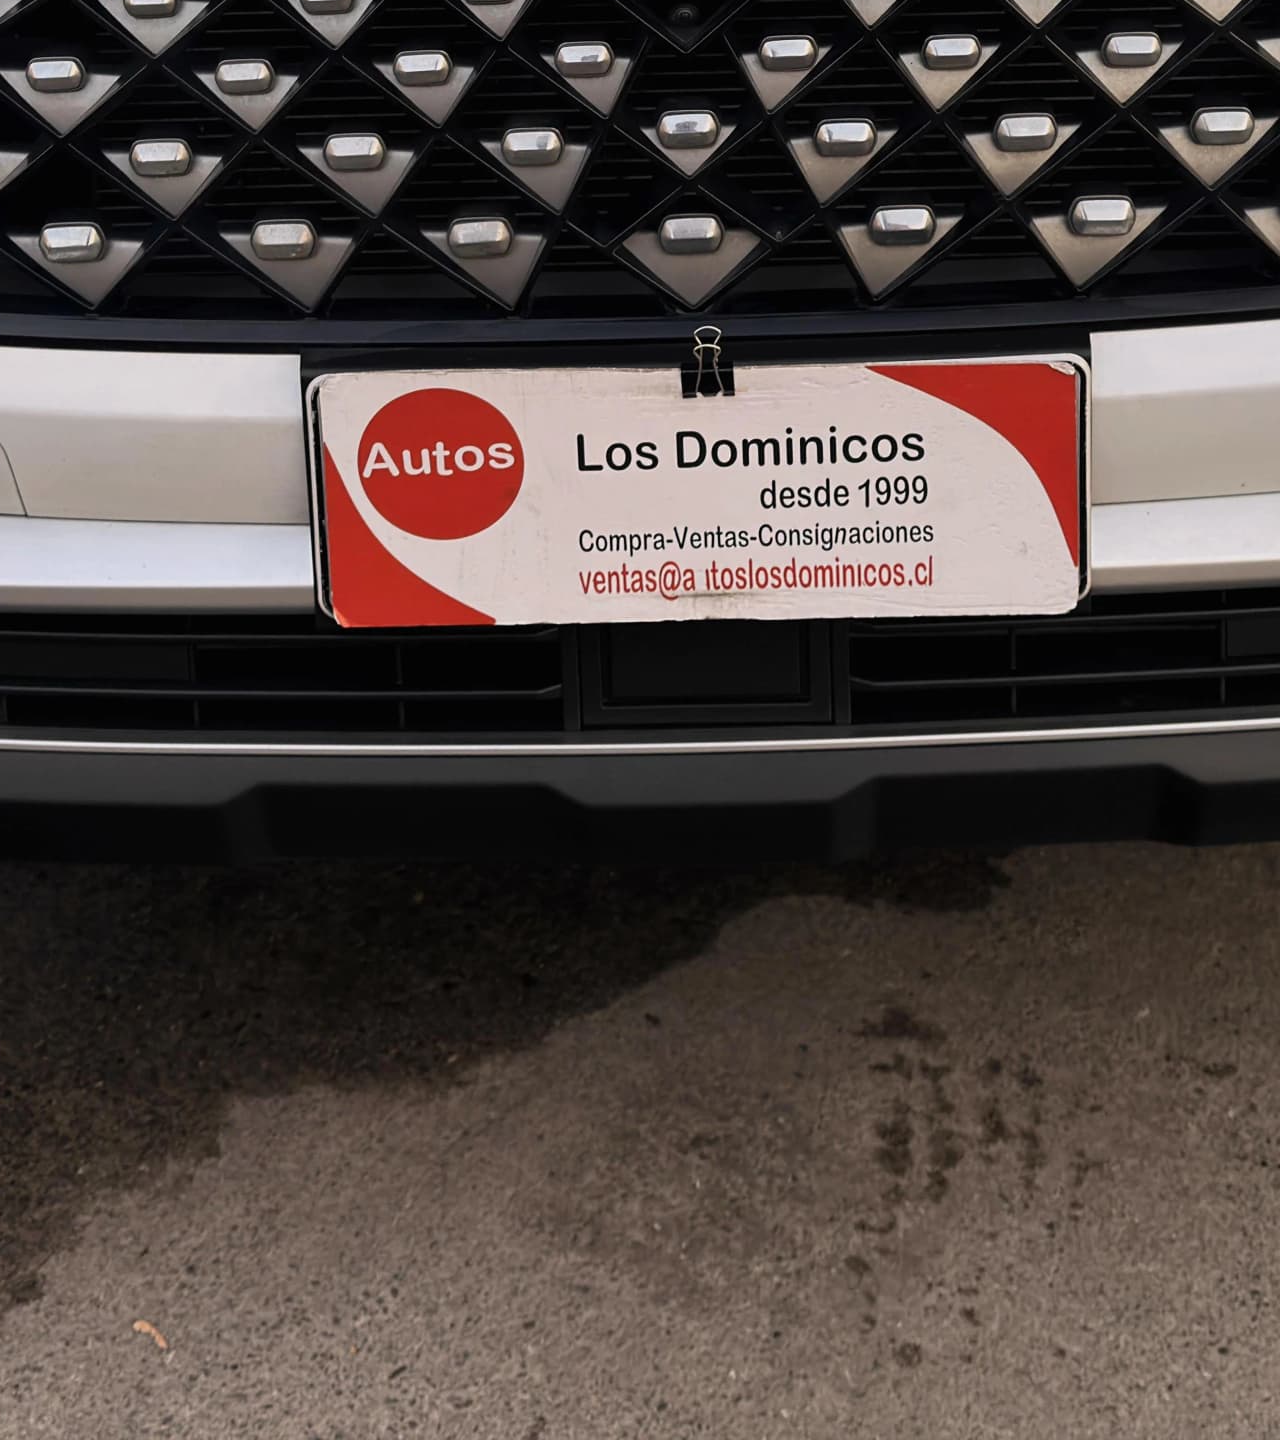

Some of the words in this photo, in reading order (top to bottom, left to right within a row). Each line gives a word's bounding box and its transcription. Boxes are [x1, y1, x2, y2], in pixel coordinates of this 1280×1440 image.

[363, 437, 515, 478] Autos
[576, 432, 660, 472] Los
[674, 426, 926, 469] Dominicos
[759, 477, 851, 509] desde
[858, 476, 929, 506] 1999
[578, 521, 935, 555] Compra-Ventas-Consignaciones
